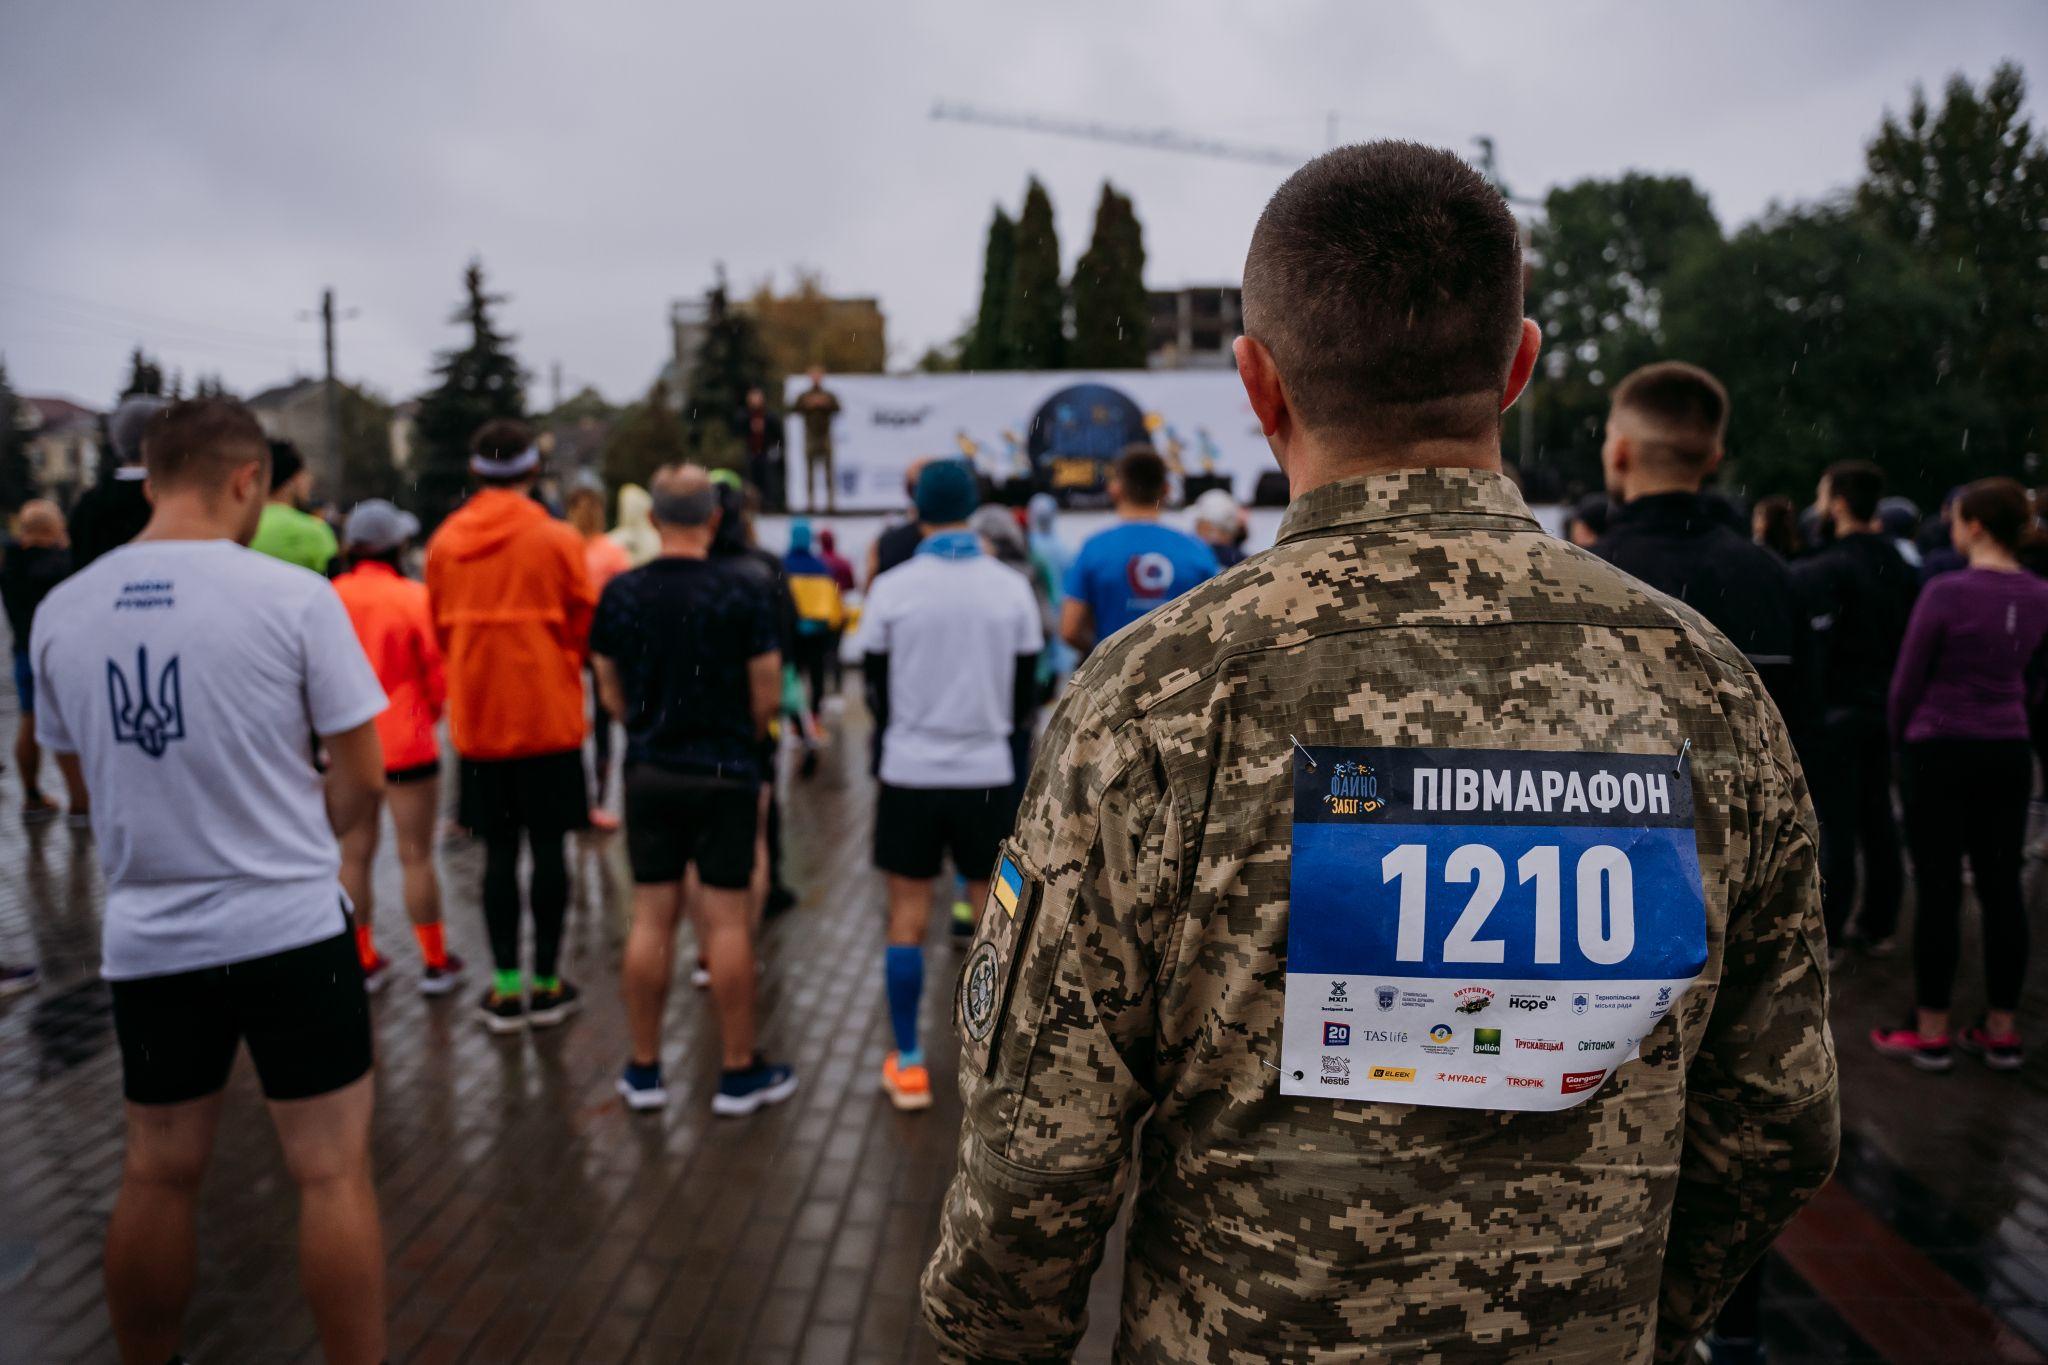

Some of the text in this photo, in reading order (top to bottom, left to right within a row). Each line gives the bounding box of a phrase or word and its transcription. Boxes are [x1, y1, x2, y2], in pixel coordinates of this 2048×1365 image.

[1331, 772, 1377, 798] ФАЙНО
[1413, 767, 1671, 814] ПІВМАРАФОН
[1381, 843, 1635, 965] 1210
[1509, 997, 1548, 1012] Hope
[1616, 1003, 1633, 1011] рада
[1328, 1026, 1348, 1040] 20
[1363, 1030, 1388, 1042] TAS
[1474, 1043, 1500, 1053] gullón
[1384, 1069, 1410, 1078] ELEEK
[1447, 1074, 1488, 1084] MYRACE
[1507, 1077, 1544, 1088] TROPIK
